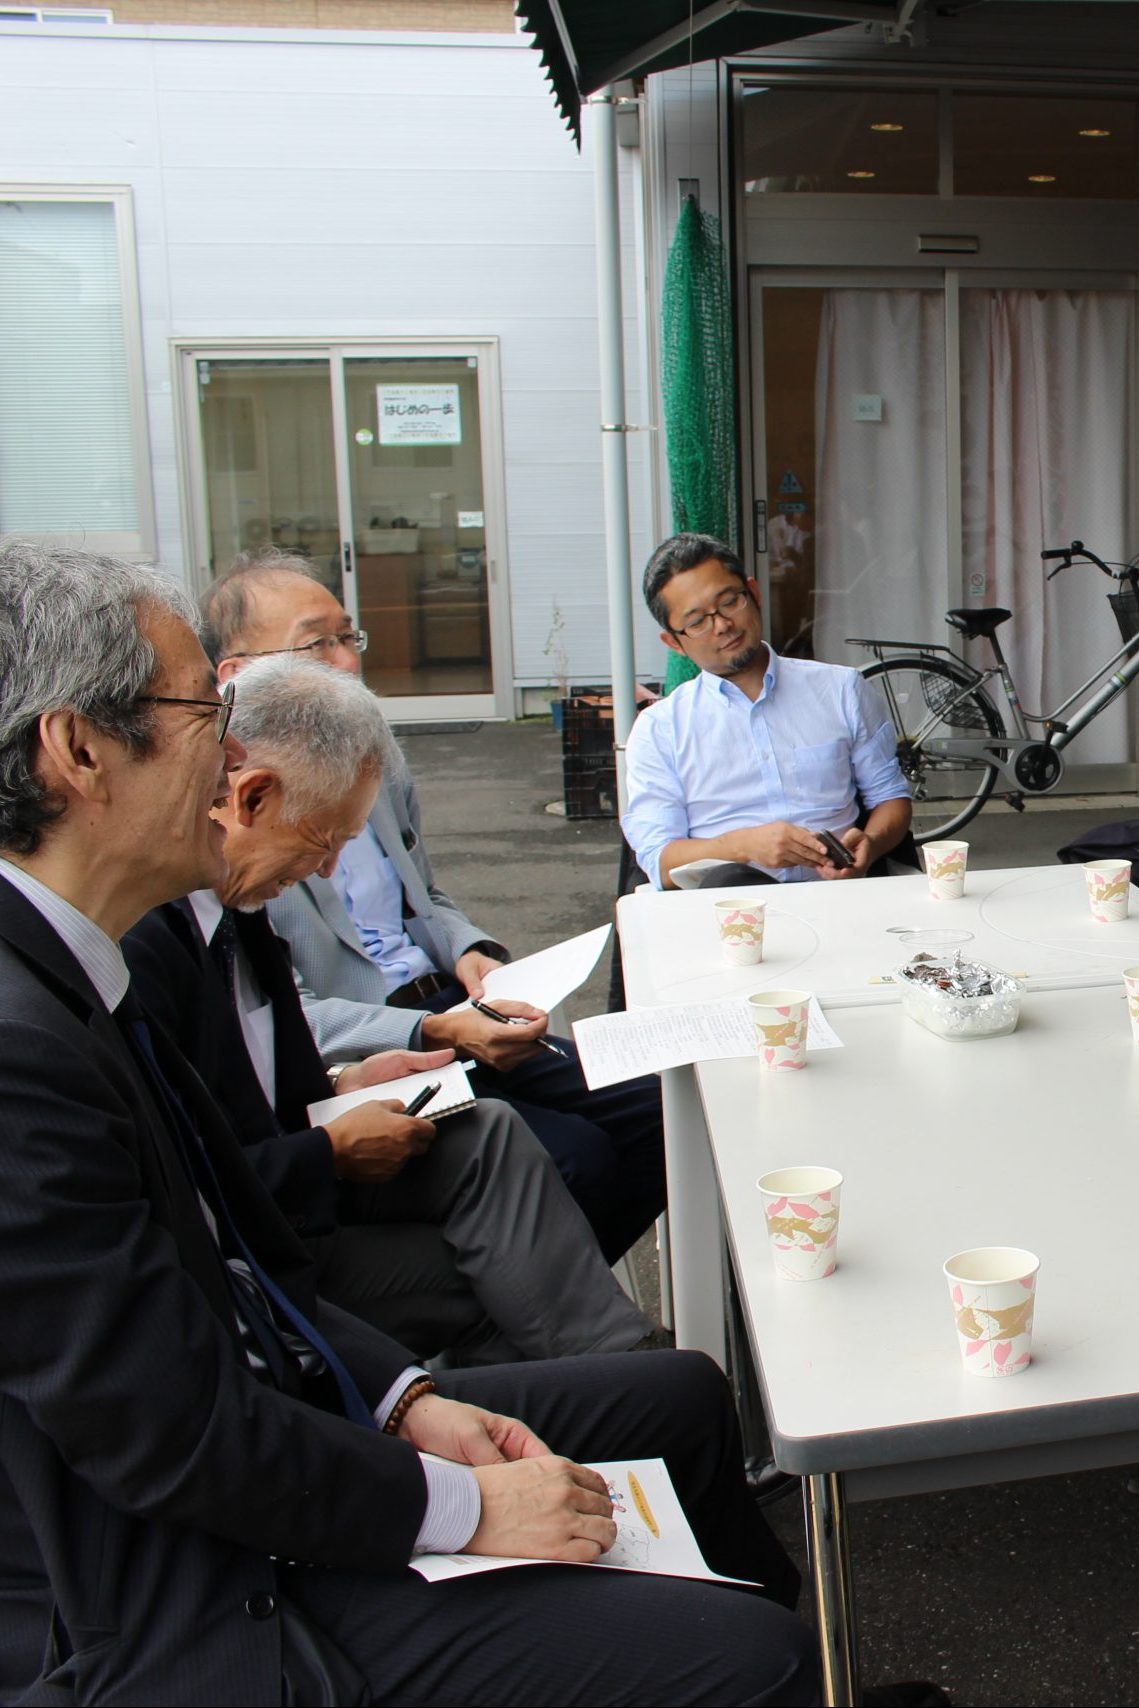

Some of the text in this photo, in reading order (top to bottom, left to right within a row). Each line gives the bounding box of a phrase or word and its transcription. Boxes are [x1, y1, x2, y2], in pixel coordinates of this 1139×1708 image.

[384, 403, 455, 416] はじめの一歩
